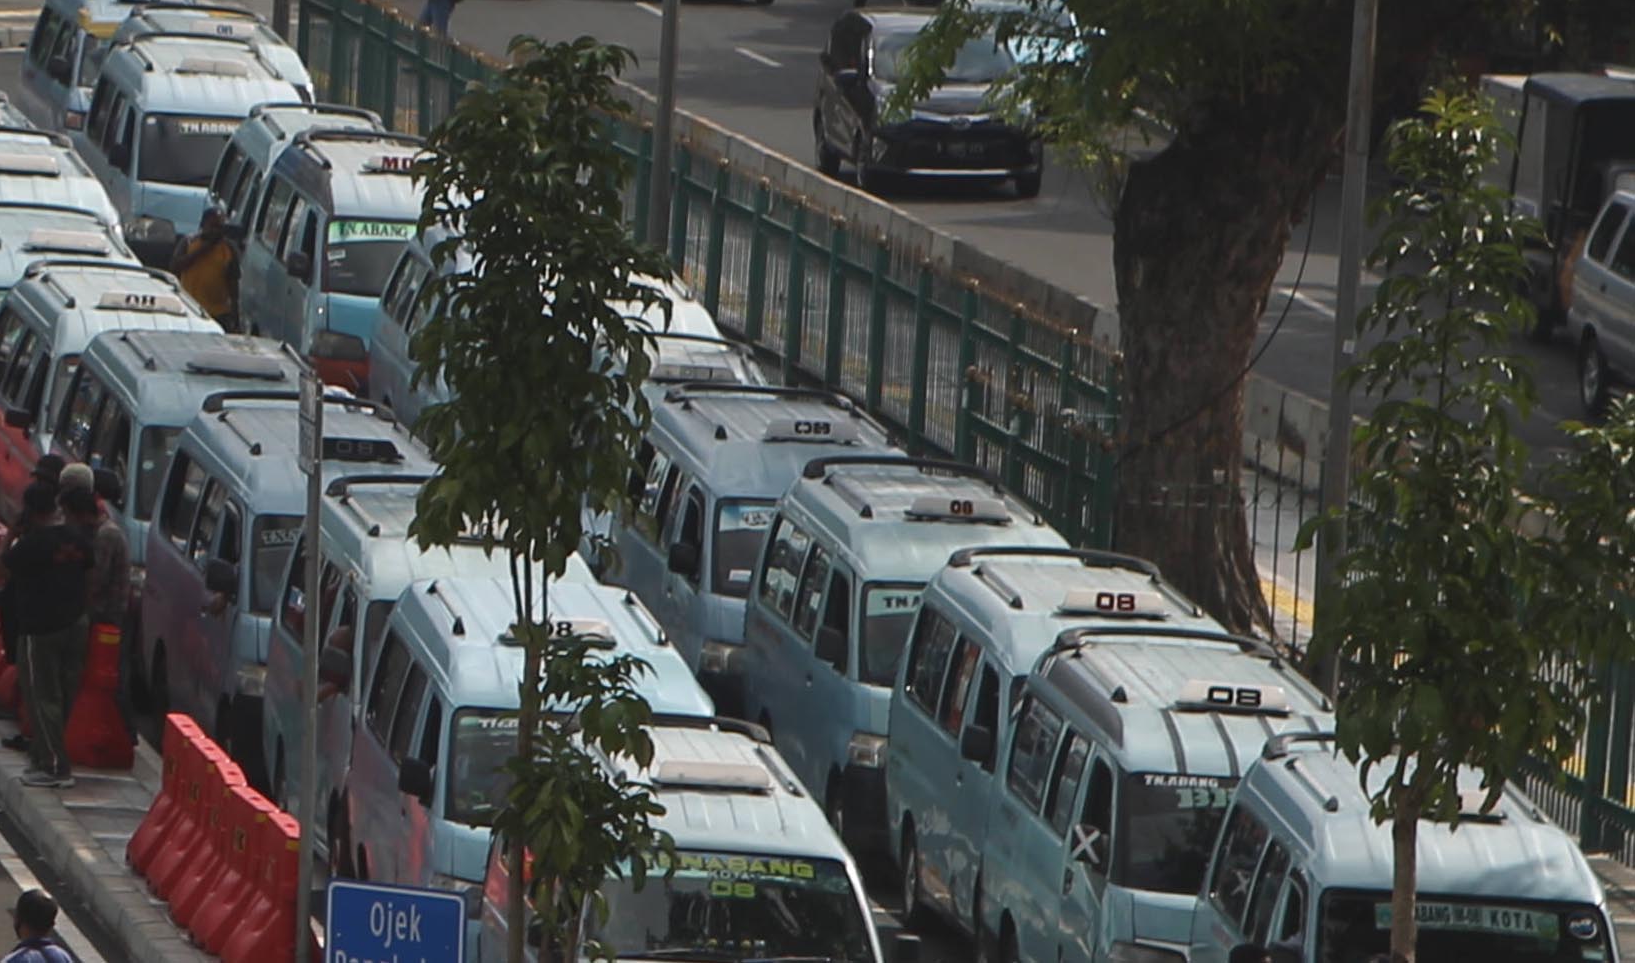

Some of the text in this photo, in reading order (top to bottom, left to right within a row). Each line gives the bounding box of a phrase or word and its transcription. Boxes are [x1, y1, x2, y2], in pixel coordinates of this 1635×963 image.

[1096, 592, 1134, 611] 08
[1207, 686, 1261, 708] 08
[711, 881, 756, 898] 08
[370, 901, 421, 948] Ojek
[1490, 909, 1534, 930] KOTA
